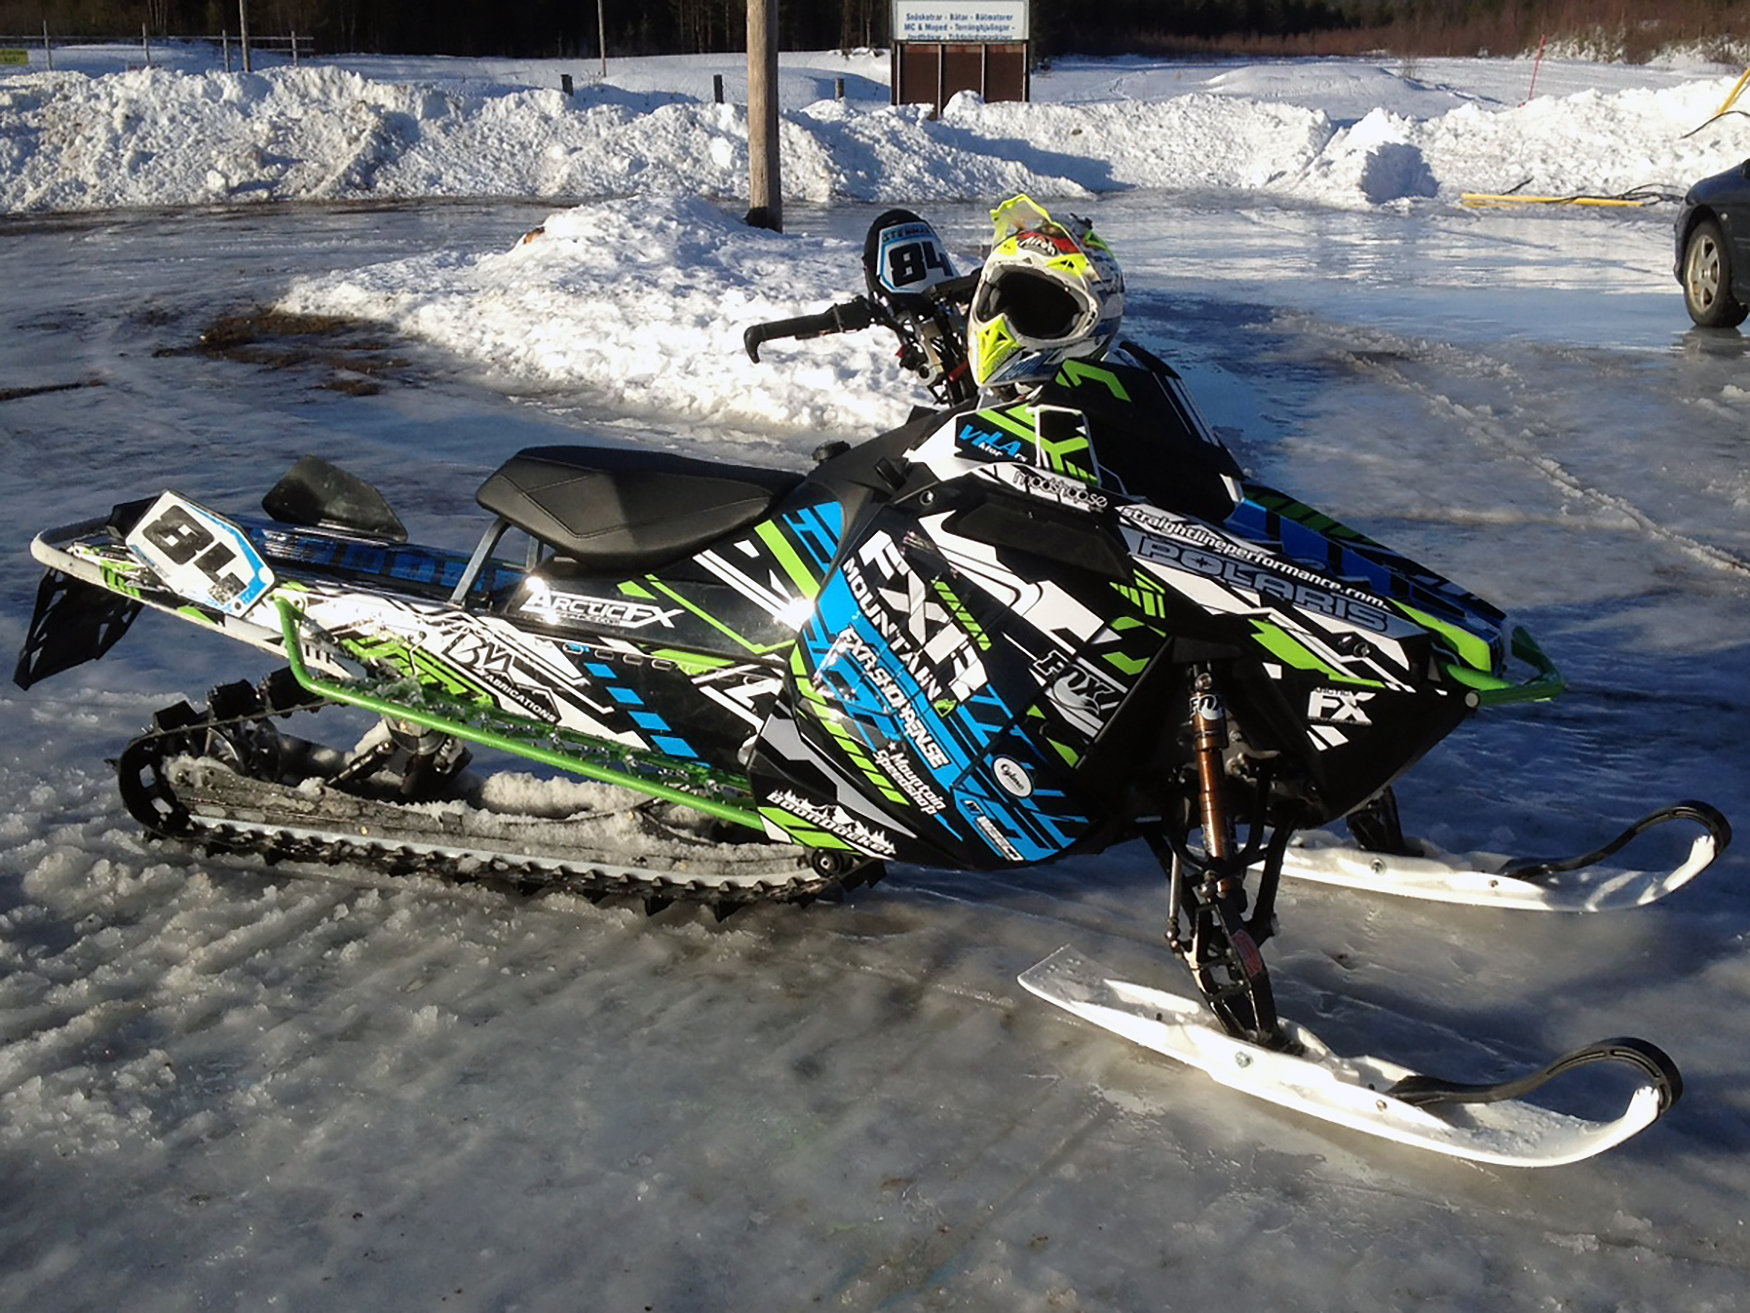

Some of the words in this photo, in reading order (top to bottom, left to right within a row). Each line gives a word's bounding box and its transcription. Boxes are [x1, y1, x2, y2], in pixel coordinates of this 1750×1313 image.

[904, 23, 915, 31] MC
[925, 23, 948, 32] Moped
[888, 241, 954, 287] 84
[1019, 235, 1056, 256] Airoh
[142, 504, 248, 606] 84
[1120, 507, 1385, 608] straightlineperformance.com
[1139, 534, 1389, 633] POLARIS
[842, 557, 942, 701] MOUNTAIN
[1033, 649, 1116, 714] FOX
[874, 749, 937, 815] Speedshop
[890, 753, 947, 810] Mountain
